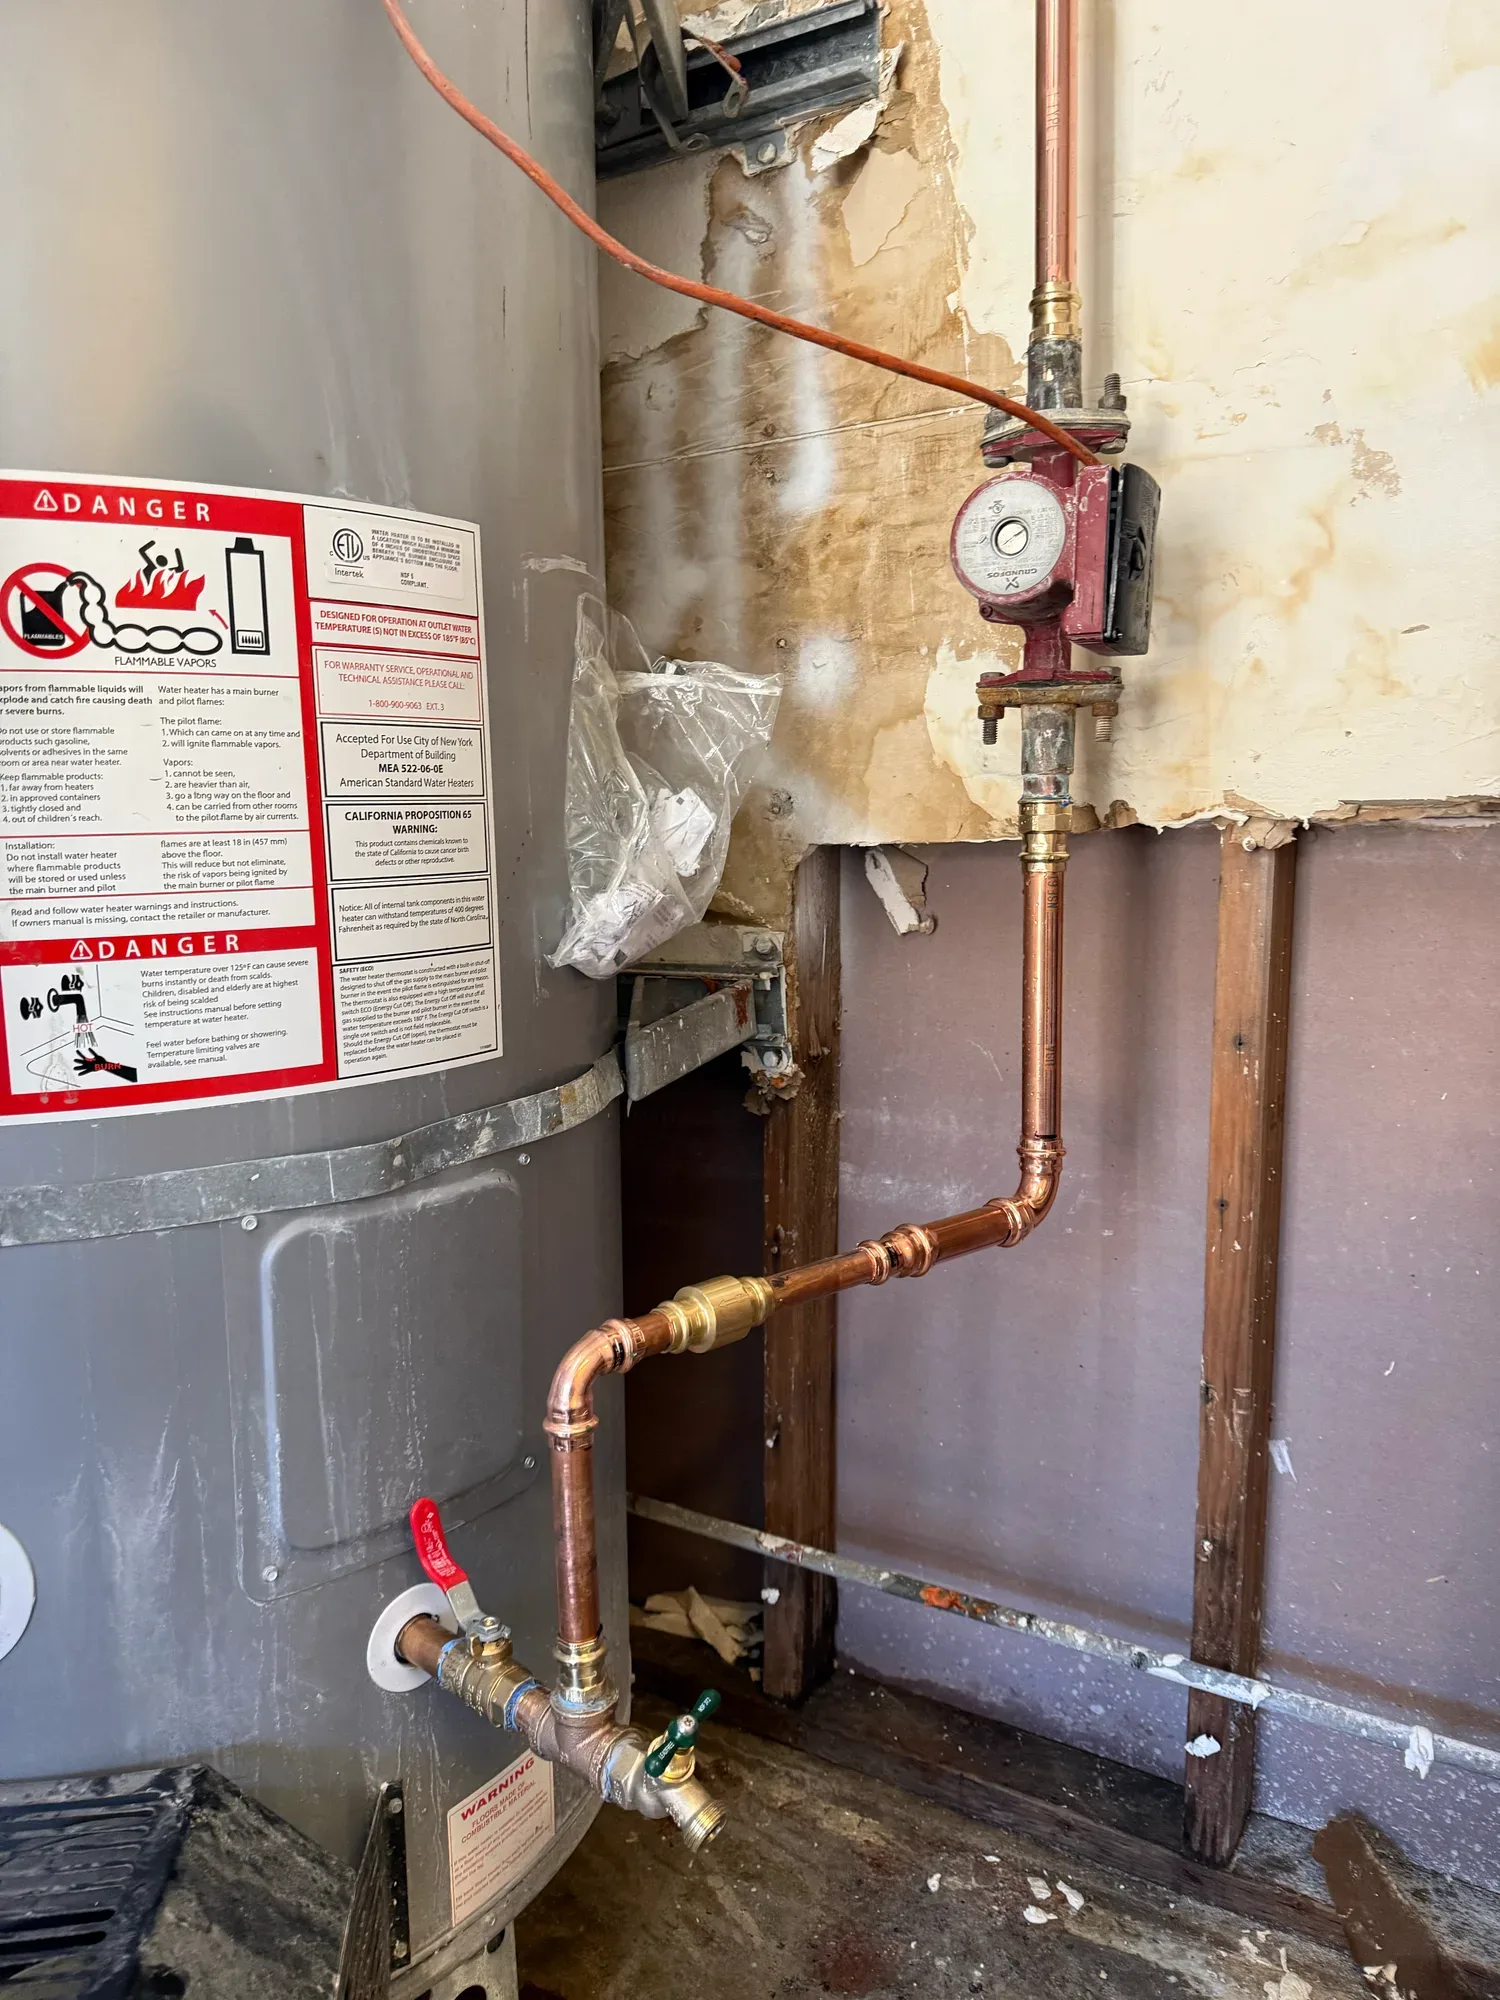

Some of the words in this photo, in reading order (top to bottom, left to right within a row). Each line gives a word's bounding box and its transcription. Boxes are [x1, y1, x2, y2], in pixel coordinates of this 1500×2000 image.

[1046, 103, 1060, 130] TYPE
[64, 495, 210, 521] DANGER
[334, 567, 364, 578] Intertek
[987, 568, 1038, 578] GRUNDFOS
[320, 610, 360, 620] DESIGNED
[361, 613, 376, 622] FOR
[377, 615, 417, 626] OPERATION
[427, 621, 451, 630] OUTLET
[452, 624, 471, 633] WATER
[315, 621, 371, 633] TEMPERATURE
[372, 626, 381, 635] (S)
[383, 627, 398, 636] NOT
[408, 630, 432, 640] EXCESS
[114, 656, 174, 666] FLAMMABLE
[176, 658, 216, 667] VAPORS
[324, 660, 340, 668] FOR
[341, 661, 384, 671] WARRANTY
[385, 664, 415, 675] SERVICE,
[416, 666, 459, 678] OPERATIONAL
[460, 671, 473, 679] AND
[338, 673, 381, 683] TECHNICAL
[382, 676, 423, 686] ASSISTANCE
[424, 679, 447, 688] PLEASE
[448, 681, 465, 690] CALL:
[48, 684, 95, 692] flammable
[97, 684, 126, 694] liquids
[157, 685, 181, 693] Water
[183, 686, 209, 694] heater
[210, 686, 224, 694] has
[232, 687, 251, 695] main
[253, 688, 278, 696] burner
[31, 695, 48, 703] and
[75, 695, 90, 703] fire
[92, 696, 125, 706] causing
[127, 696, 152, 704] death
[158, 696, 174, 704] and
[176, 697, 194, 706] pilot
[196, 697, 224, 705] flames:
[368, 699, 421, 709] 1-800-900-9063
[426, 702, 439, 710] EXT.
[36, 707, 64, 715] burns.
[159, 716, 175, 724] The
[177, 717, 195, 726] pilot
[197, 717, 221, 725] flame:
[335, 733, 378, 745] Accepted
[381, 734, 394, 744] For
[396, 735, 412, 744] Use
[413, 735, 429, 747] City
[430, 736, 438, 745] of
[440, 736, 456, 746] New
[457, 737, 473, 747] York
[361, 748, 413, 760] Department
[415, 749, 423, 759] of
[425, 750, 455, 762] Building
[162, 758, 193, 767] Vapors:
[378, 763, 399, 772] MEA
[401, 764, 443, 773] 522-06-0E
[340, 777, 383, 787] American
[385, 777, 422, 787] Standard
[423, 778, 446, 787] Water
[447, 778, 473, 787] Heaters
[345, 811, 403, 820] CALIFORNIA
[405, 810, 461, 819] PROPOSITION
[462, 810, 471, 818] 65
[392, 824, 437, 833] WARNING:
[5, 841, 54, 849] Installation:
[232, 838, 241, 846] 18
[252, 838, 268, 846] (457
[270, 837, 287, 845] mm)
[202, 849, 222, 857] floor.
[1047, 890, 1058, 909] NSF
[11, 907, 32, 916] Read
[34, 907, 50, 915] and
[52, 906, 78, 914] follow
[106, 904, 132, 912] heater
[134, 903, 171, 911] warnings
[173, 901, 188, 909] and
[190, 900, 238, 908] instructions.
[11, 919, 17, 927] If
[52, 916, 83, 925] manual
[85, 916, 92, 924] is
[94, 915, 128, 924] missing,
[129, 914, 160, 922] contact
[177, 911, 205, 919] retailer
[217, 908, 270, 917] manufacturer.
[98, 934, 240, 959] DANGER
[164, 967, 211, 976] temperature
[165, 977, 197, 985] instantly
[207, 974, 229, 982] death
[249, 971, 272, 979] scalds.
[142, 989, 176, 997] Children,
[177, 986, 209, 995] disabled
[226, 983, 250, 991] elderly
[272, 979, 298, 988] highest
[73, 1023, 93, 1033] HOT
[343, 1056, 370, 1064] operation
[371, 1053, 388, 1061] again.
[94, 1062, 121, 1071] BURN
[461, 1757, 535, 1820] WARNING
[472, 1805, 498, 1828] FLOORS
[499, 1790, 516, 1804] MADE
[518, 1782, 526, 1792] OF
[462, 1806, 507, 1843] COMBUSTIBLE
[508, 1780, 536, 1807] MATERIAL
